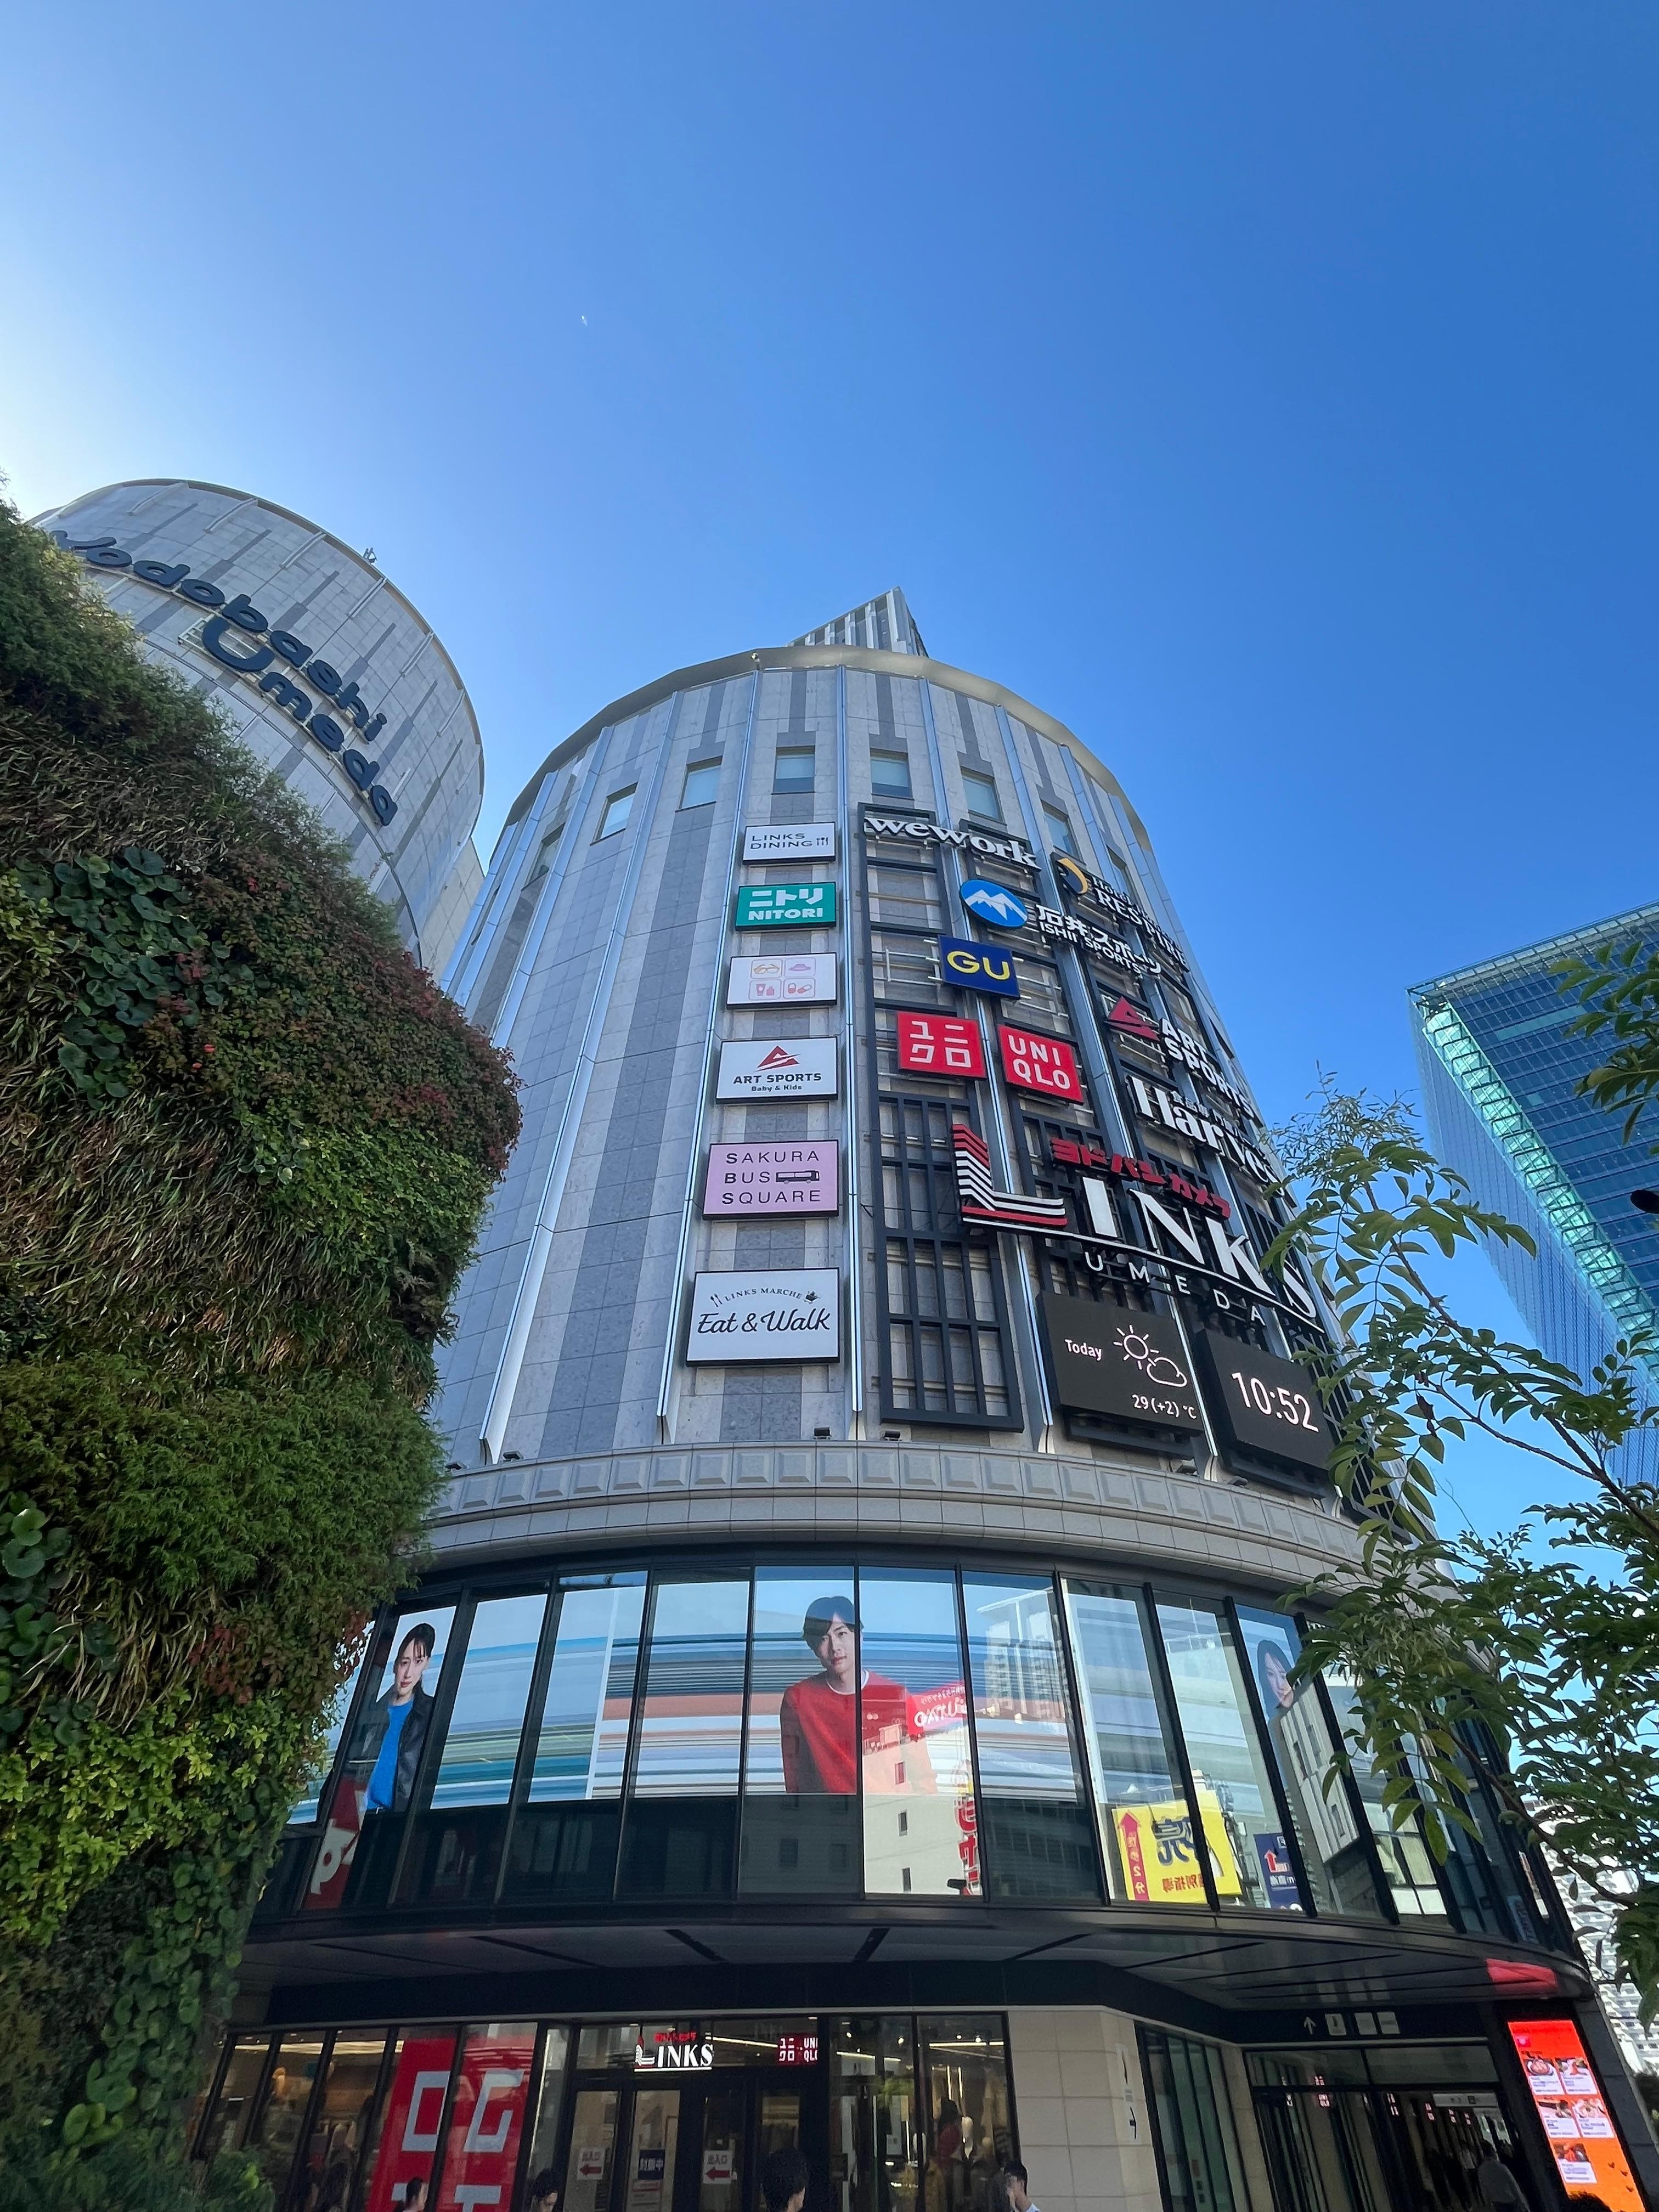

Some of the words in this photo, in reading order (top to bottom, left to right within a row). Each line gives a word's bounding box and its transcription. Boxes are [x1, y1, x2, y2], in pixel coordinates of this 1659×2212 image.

[50, 530, 387, 742] Yodobashi
[201, 615, 398, 827] Umeda
[750, 840, 812, 849] DINING
[752, 833, 805, 842] LINKS
[864, 818, 1041, 872] wework
[749, 888, 823, 907] ニトリ
[1092, 877, 1132, 905] Hotel
[748, 908, 823, 921] NITORI
[1095, 888, 1190, 971] RESPIRE
[1036, 904, 1161, 974] 石井スポーツ
[1040, 922, 1077, 943] ISHII
[1086, 937, 1142, 974] SPORTS
[947, 950, 1011, 981] GU
[1008, 1034, 1060, 1068] UNI
[1161, 1018, 1209, 1063] ART
[733, 1074, 761, 1085] ART
[766, 1072, 822, 1083] SPORTS
[1012, 1059, 1070, 1090] QLO
[1164, 1037, 1255, 1118] SPORTS
[726, 1150, 820, 1164] SAKURA
[724, 1171, 770, 1184] BUS
[1051, 1137, 1231, 1220] ヨドバシカメラ
[721, 1189, 821, 1205] SQUARE
[952, 1124, 1317, 1318] LINKS
[724, 1288, 757, 1301] LINKS
[760, 1287, 803, 1299] MARCHE
[1085, 1251, 1266, 1325] UMEDA
[697, 1312, 740, 1334] Eat
[742, 1312, 758, 1332] &
[760, 1308, 831, 1331] Walk
[1064, 1338, 1103, 1362] Today
[1232, 1372, 1319, 1433] 10:52
[635, 2036, 713, 2067] LINKS
